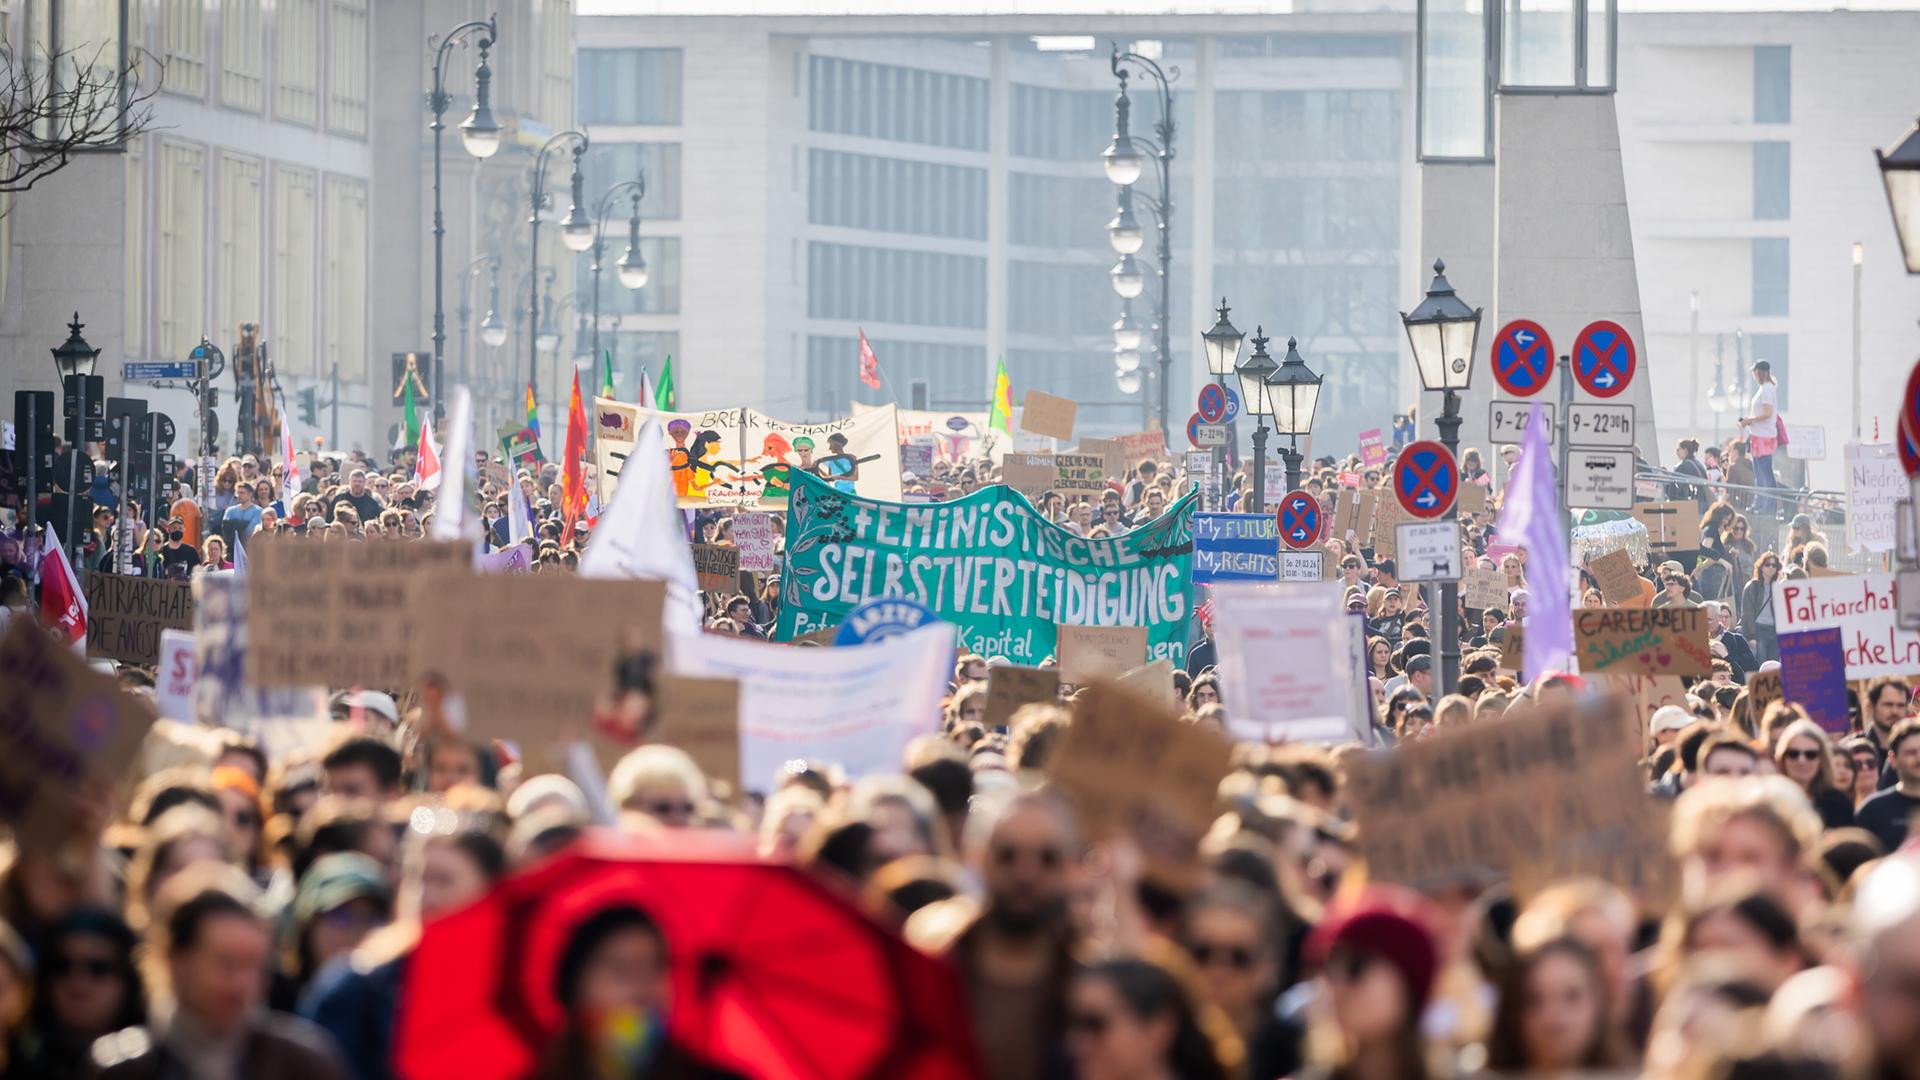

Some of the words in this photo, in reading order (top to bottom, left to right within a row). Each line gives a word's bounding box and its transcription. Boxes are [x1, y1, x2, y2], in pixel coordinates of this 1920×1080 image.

[700, 410, 760, 429] BREAK
[764, 418, 786, 431] the
[790, 417, 855, 436] CHAINS
[1198, 517, 1221, 542] My
[1197, 549, 1221, 575] My
[1222, 551, 1276, 574] RIGHTS
[87, 617, 115, 651] DIE
[957, 625, 1032, 659] Kapital
